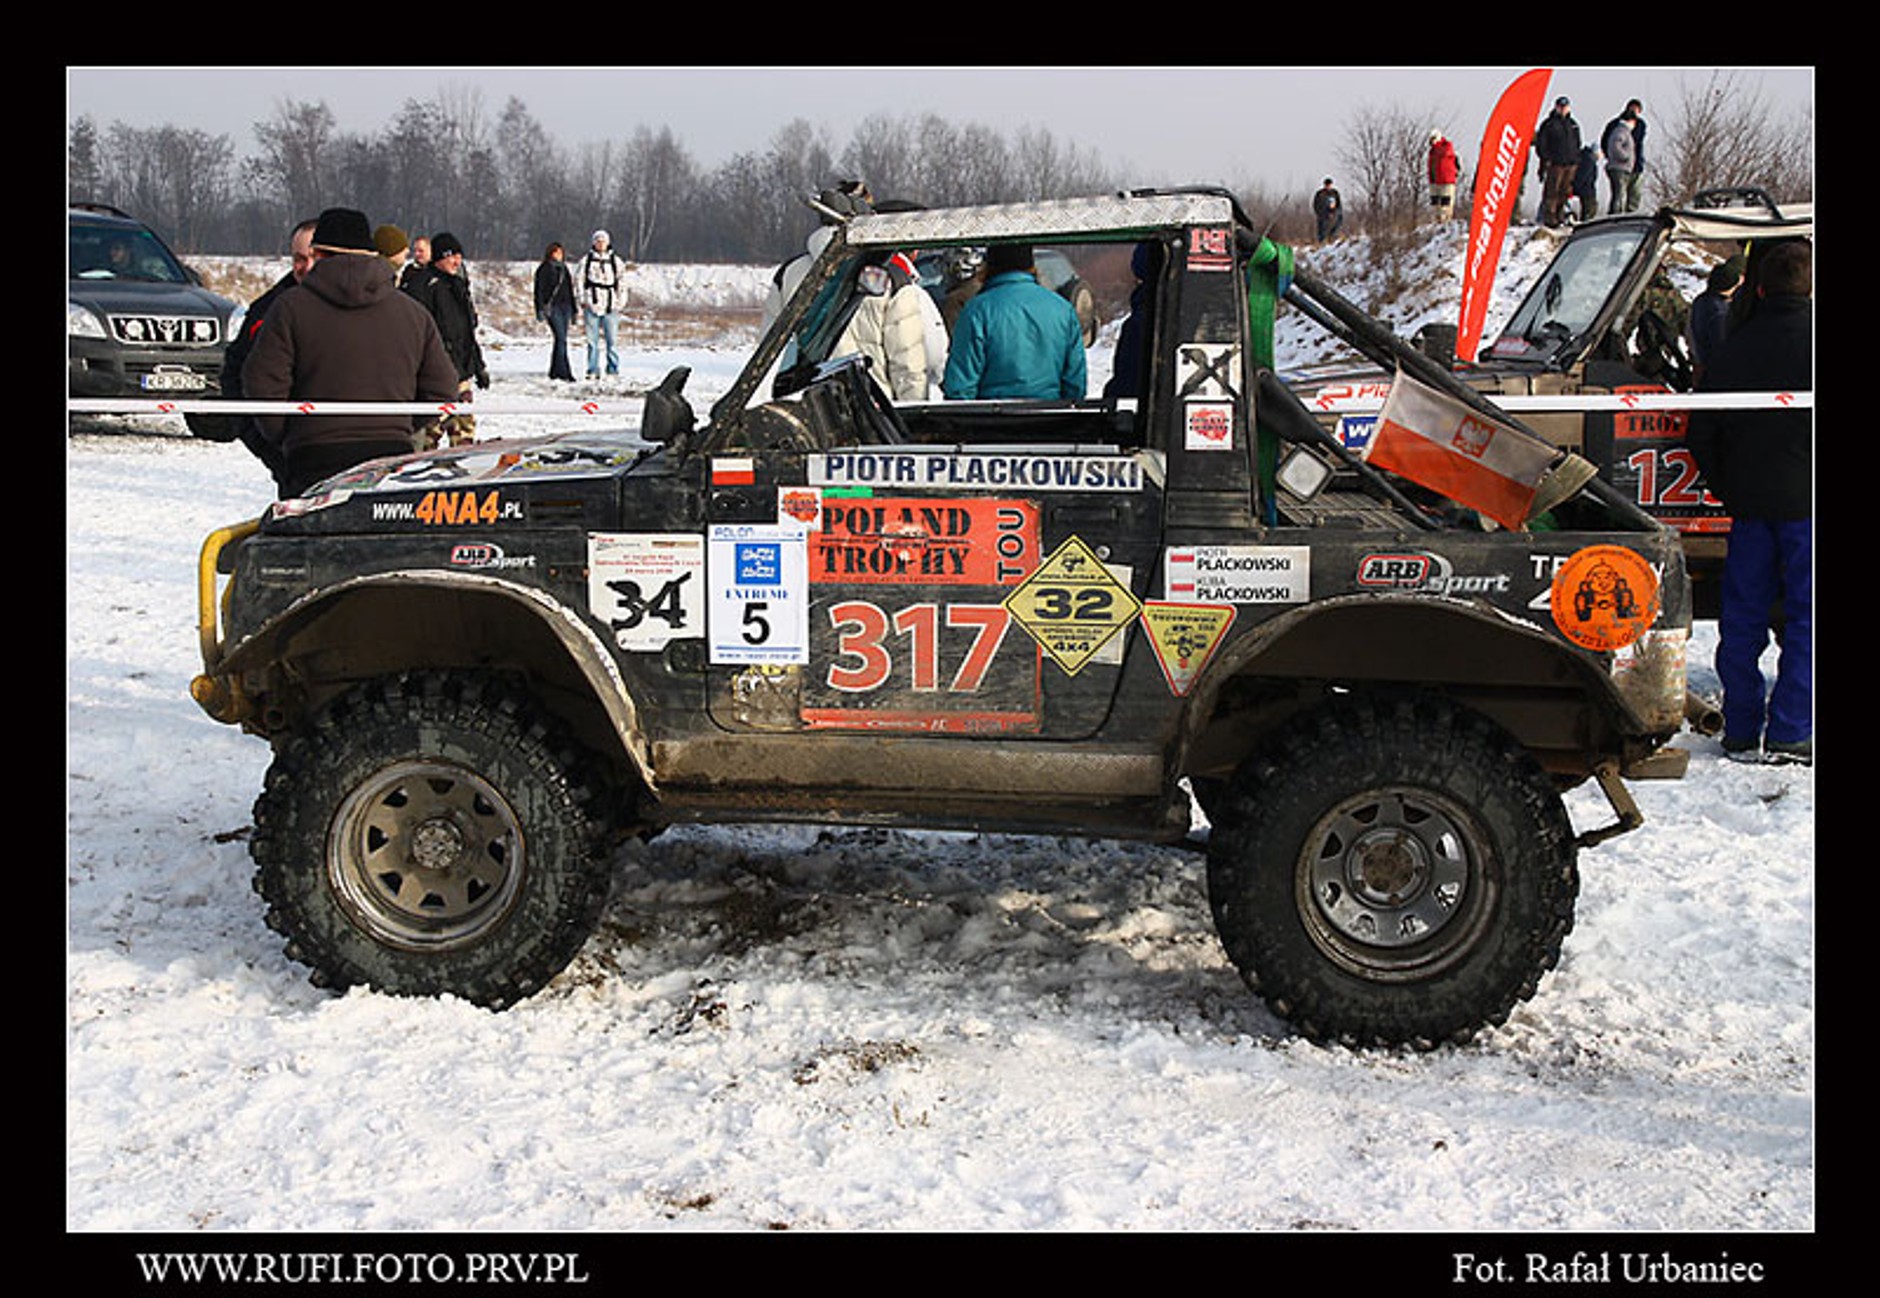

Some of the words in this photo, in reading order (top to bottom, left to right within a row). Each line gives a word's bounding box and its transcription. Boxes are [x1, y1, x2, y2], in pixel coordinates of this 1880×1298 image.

[825, 455, 916, 483] PIOTR
[821, 506, 972, 537] POLAND
[820, 546, 970, 576] TROPHY
[1365, 560, 1422, 579] ARB
[605, 571, 692, 631] 34
[725, 588, 789, 600] EXTREME
[1034, 587, 1114, 620] 32
[741, 602, 771, 645] 5
[826, 600, 1012, 693] 317
